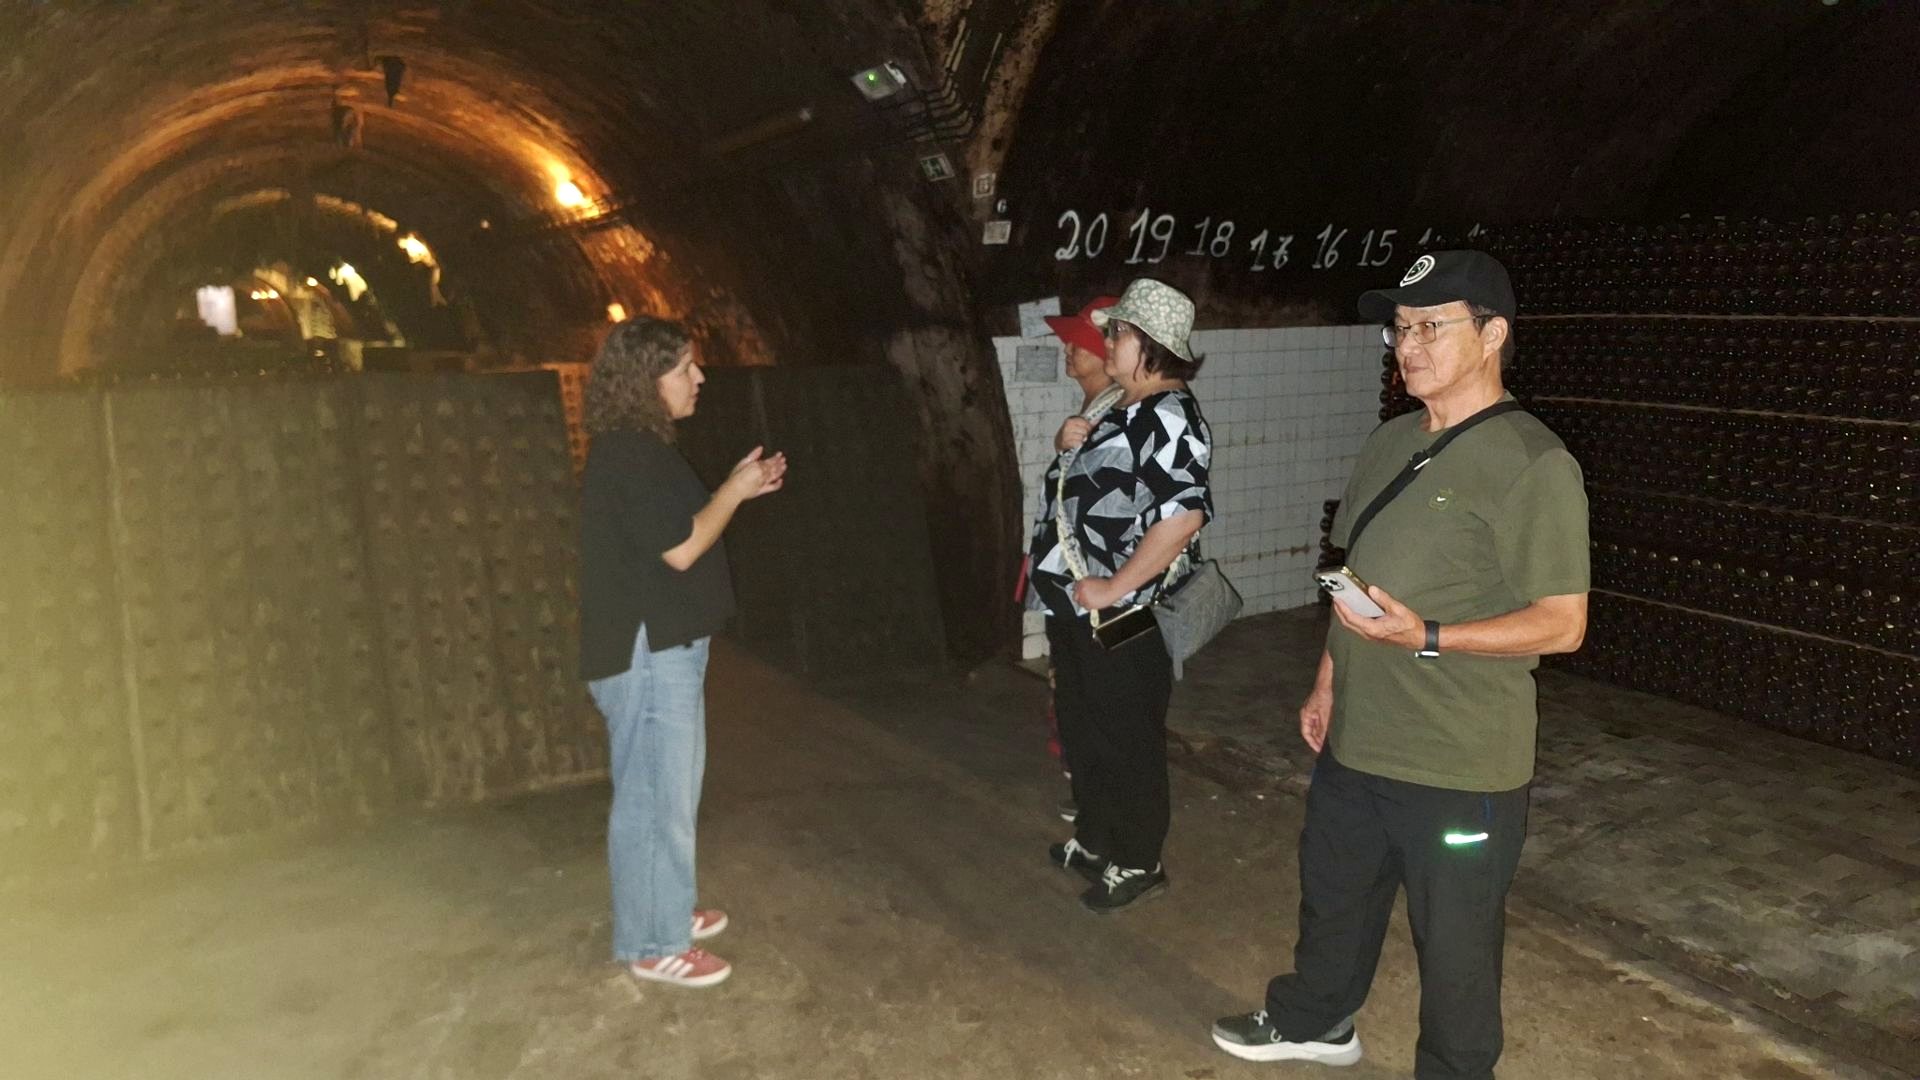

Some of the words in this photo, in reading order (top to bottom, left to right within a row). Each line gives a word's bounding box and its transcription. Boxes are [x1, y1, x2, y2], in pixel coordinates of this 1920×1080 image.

[1055, 209, 1108, 260] 20
[1124, 207, 1175, 264] 19
[1185, 216, 1235, 258] 18
[1311, 223, 1348, 269] 16
[1356, 229, 1398, 267] 15
